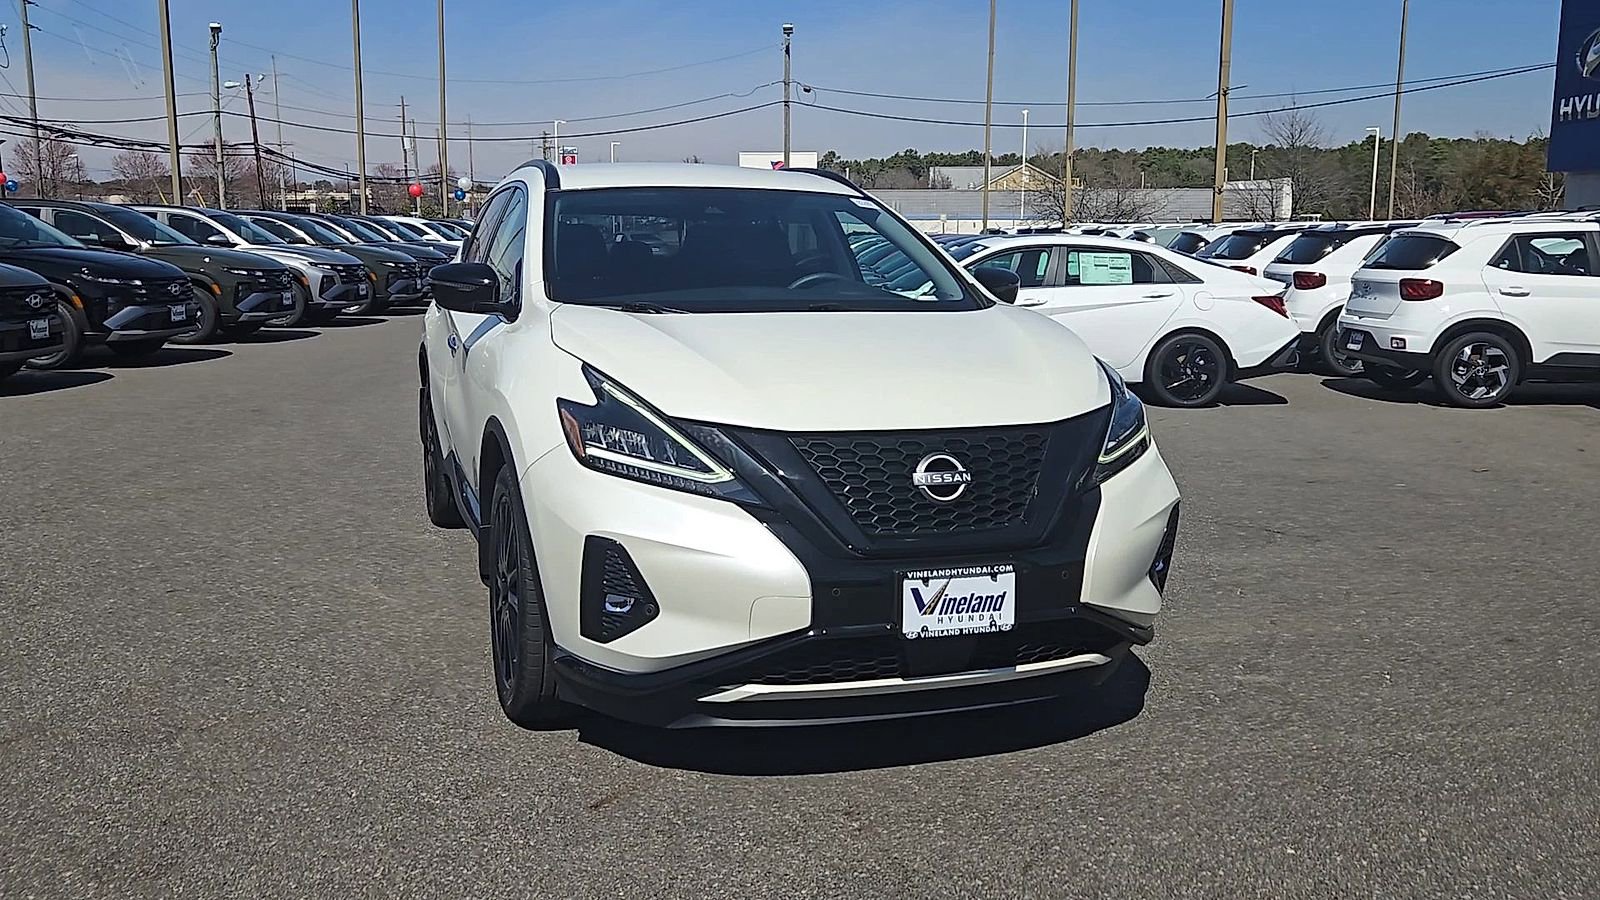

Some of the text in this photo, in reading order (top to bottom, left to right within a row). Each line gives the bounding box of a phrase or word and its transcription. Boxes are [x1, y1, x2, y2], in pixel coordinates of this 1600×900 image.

[915, 473, 971, 483] NISSAN
[907, 564, 1013, 578] VINELANDHYUNDAI.COM
[910, 577, 1007, 616] Vineland
[937, 613, 1002, 624] HYUNDAI
[920, 625, 1000, 638] VINELAND HYUNDAI
